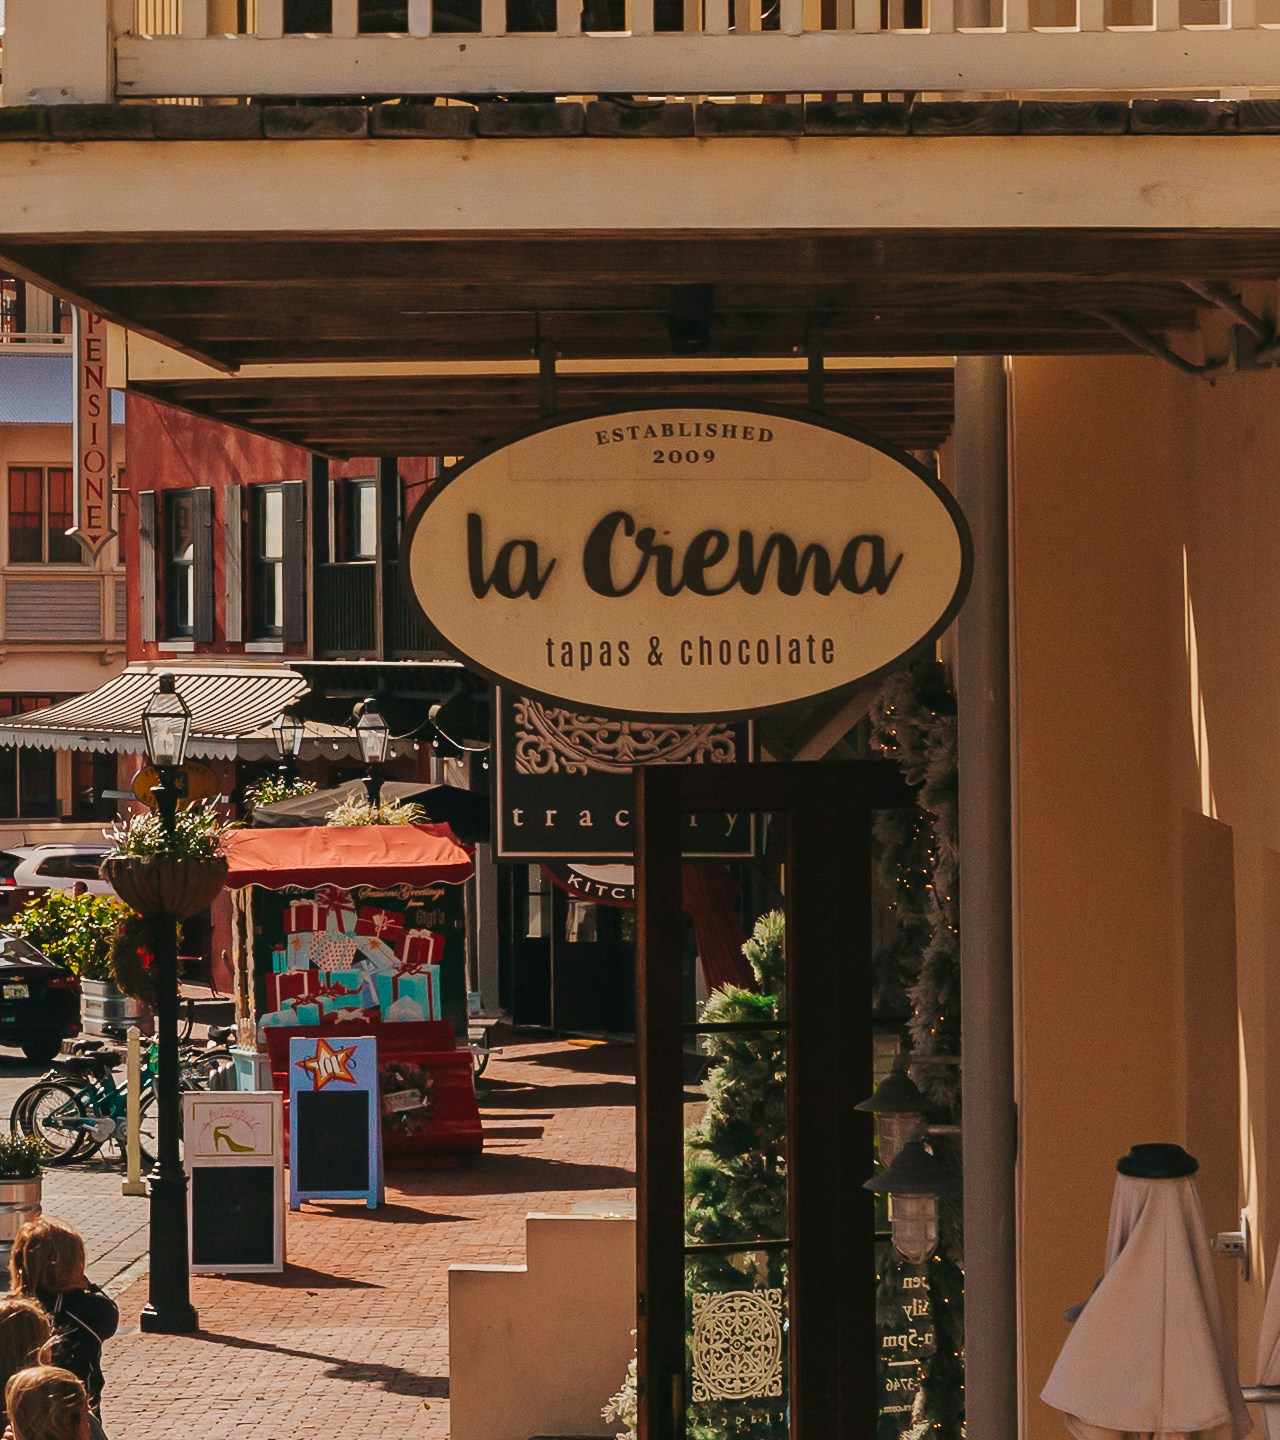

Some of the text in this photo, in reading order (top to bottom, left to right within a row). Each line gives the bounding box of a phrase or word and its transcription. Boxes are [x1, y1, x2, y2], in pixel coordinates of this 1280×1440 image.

[83, 311, 107, 530] PENSIONE
[595, 421, 776, 447] ESTABLISHED
[652, 448, 717, 465] 2009
[466, 510, 904, 600] la Crema
[545, 633, 836, 672] tapas & chocolate
[566, 872, 635, 900] KITC
